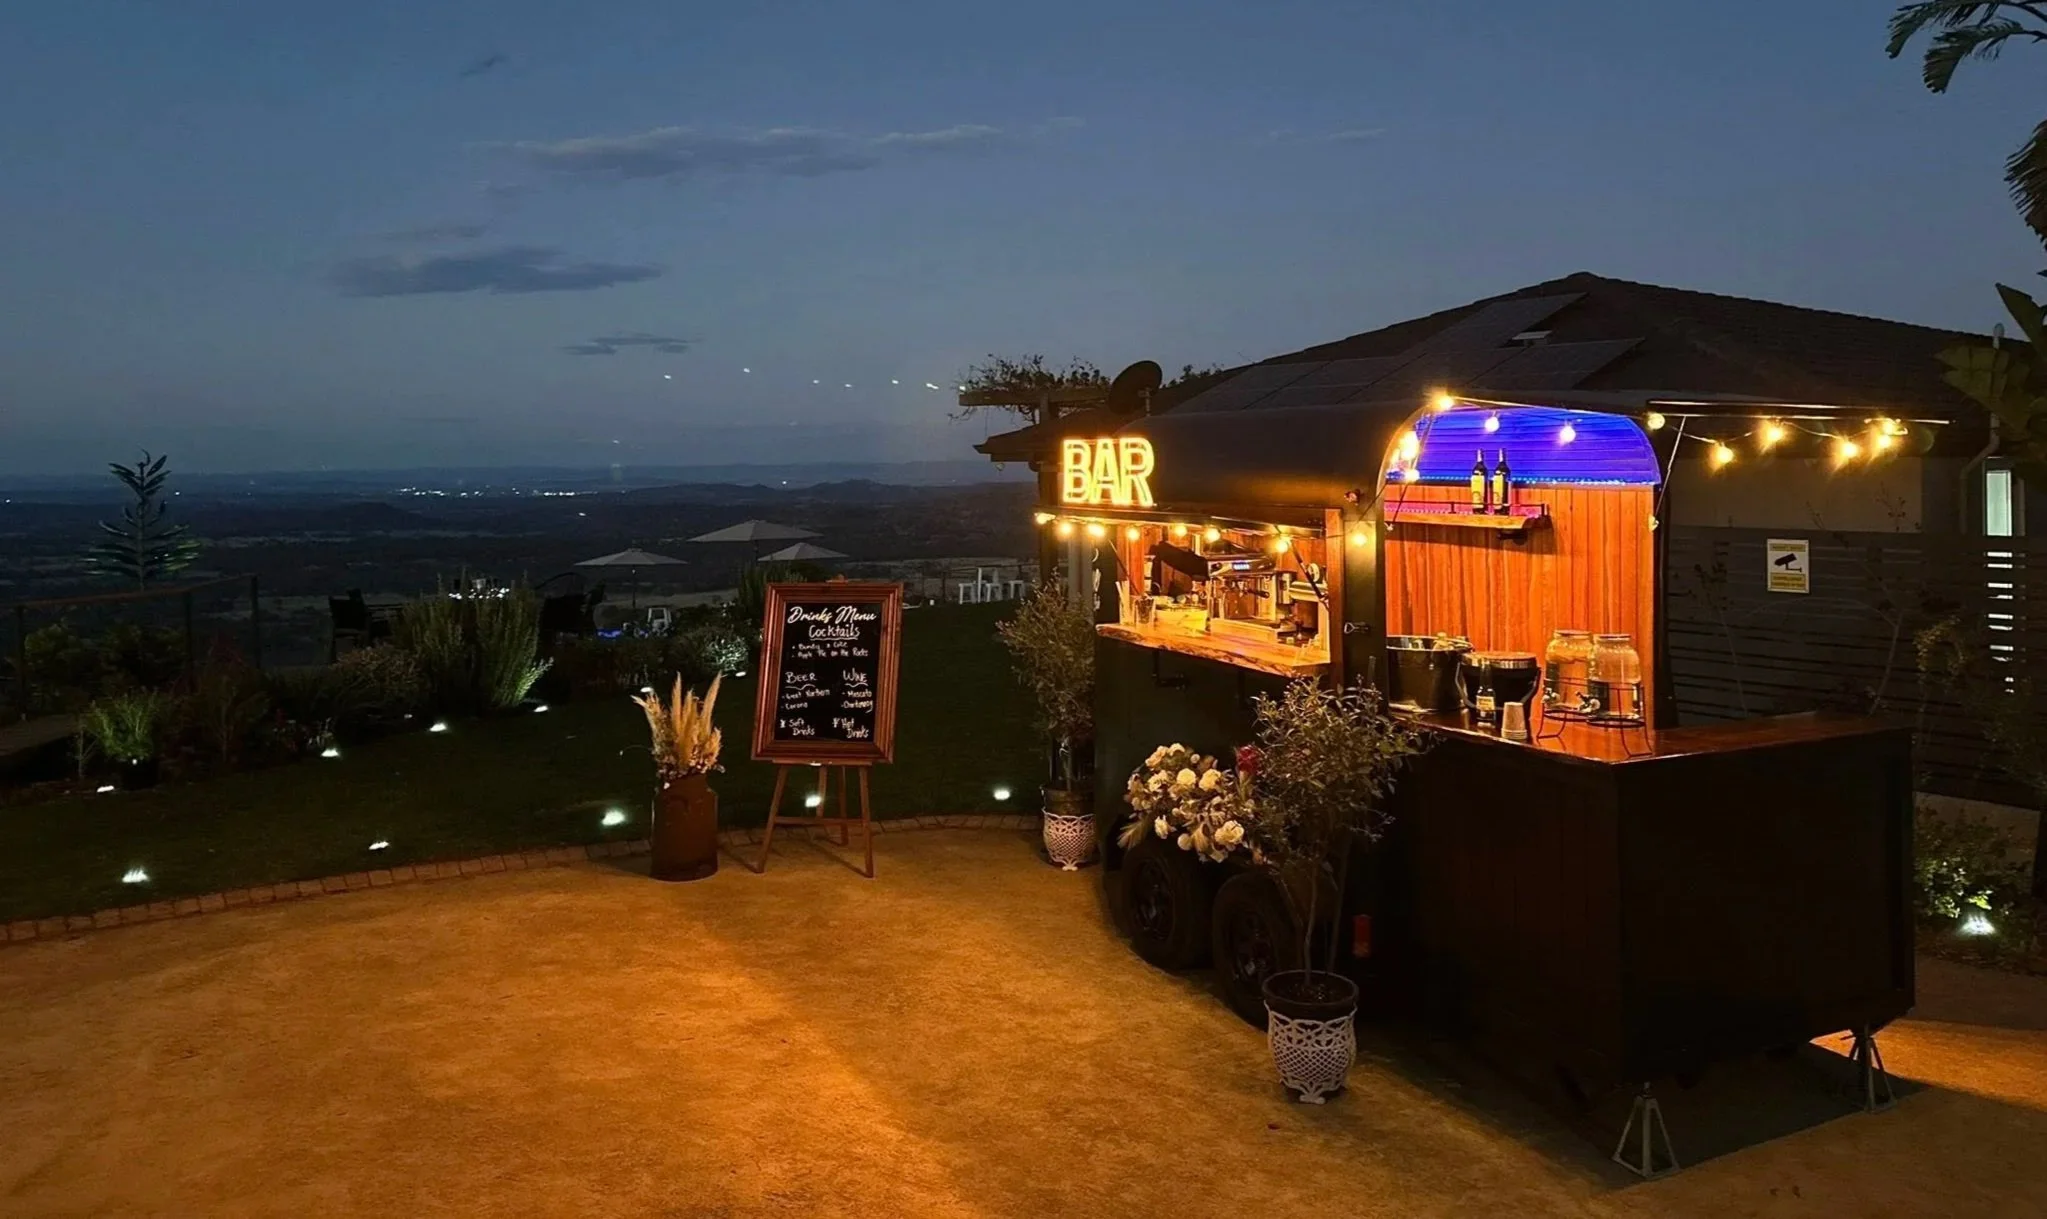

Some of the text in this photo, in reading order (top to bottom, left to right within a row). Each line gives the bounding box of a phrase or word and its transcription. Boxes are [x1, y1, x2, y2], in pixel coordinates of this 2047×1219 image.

[1062, 437, 1155, 507] BAR
[787, 605, 877, 624] Drinks Menu
[808, 623, 861, 639] Cocktails
[842, 667, 868, 683] WINE
[788, 717, 805, 727] Soft
[840, 717, 855, 729] Hot
[792, 724, 816, 736] Drinks
[846, 724, 870, 739] Drinks
